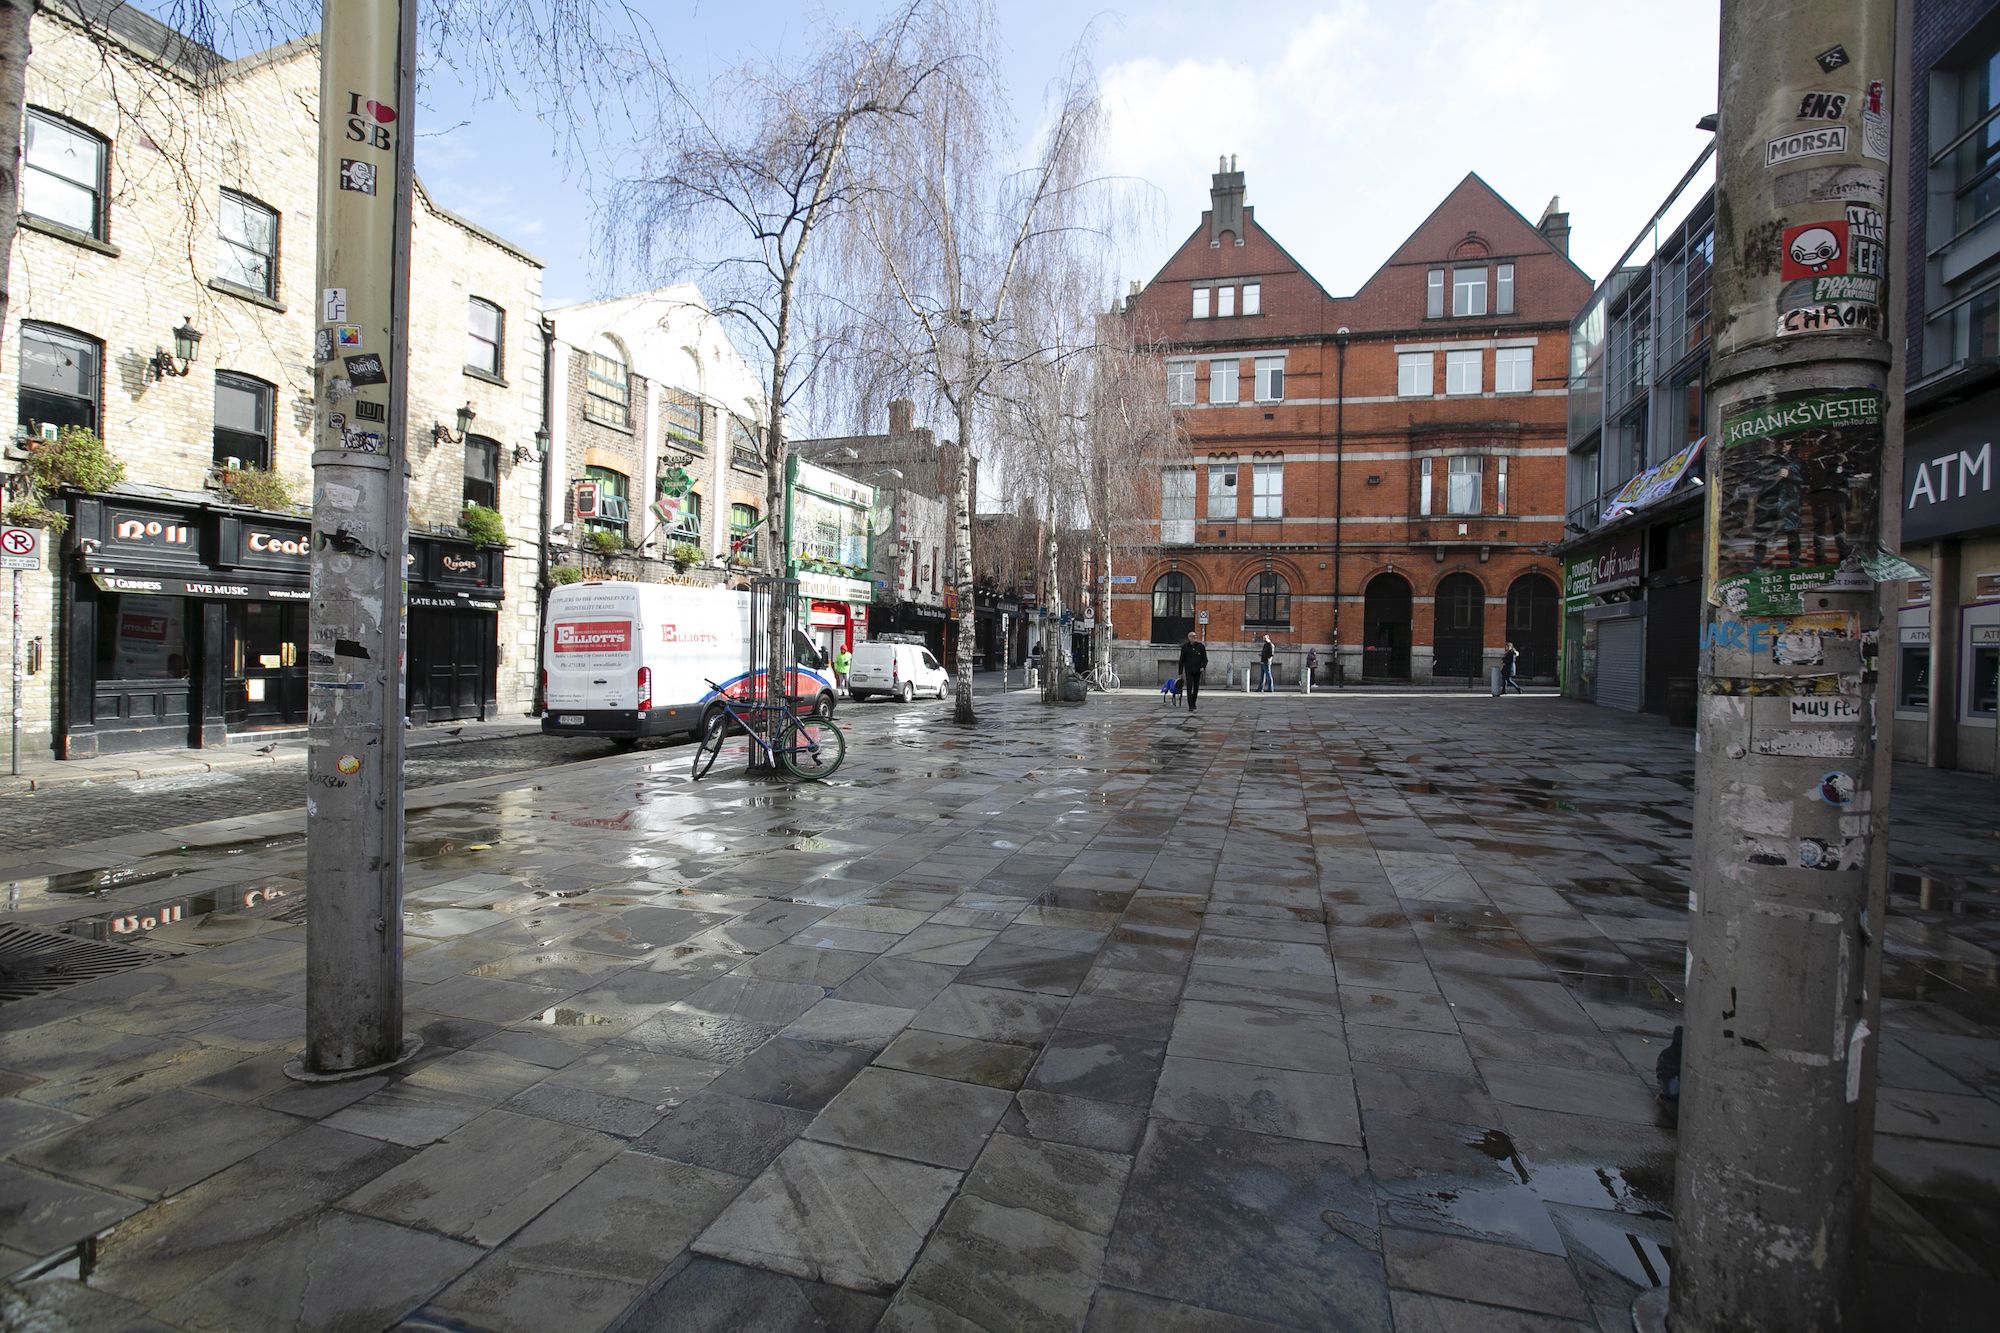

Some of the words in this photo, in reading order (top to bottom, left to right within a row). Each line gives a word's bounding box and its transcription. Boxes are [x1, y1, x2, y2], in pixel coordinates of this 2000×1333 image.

[346, 91, 362, 116] I
[1798, 93, 1846, 119] ENS
[346, 118, 391, 151] SB
[1770, 130, 1842, 161] MORSA
[1826, 289, 1841, 299] THE
[1730, 397, 1878, 442] KRANKŠVESTER
[1908, 442, 1992, 510] ATM
[1571, 559, 1593, 578] TOURIST
[1597, 546, 1617, 583] Café
[116, 578, 162, 590] GUINNESS
[1789, 571, 1825, 582] Galway
[186, 583, 213, 594] LIVE
[214, 584, 249, 595] MUSIC
[1572, 577, 1591, 595] OFFICE
[1760, 584, 1785, 595] 14.12.
[1789, 582, 1821, 591] Dublin
[411, 597, 431, 606] LATE
[438, 599, 457, 607] LIVE
[1767, 593, 1793, 603] 15.12.
[557, 626, 625, 644] ELLIOTTS
[661, 623, 718, 642] ELLIOTTS
[1910, 631, 1930, 640] ATM
[1791, 700, 1829, 718] MUY
